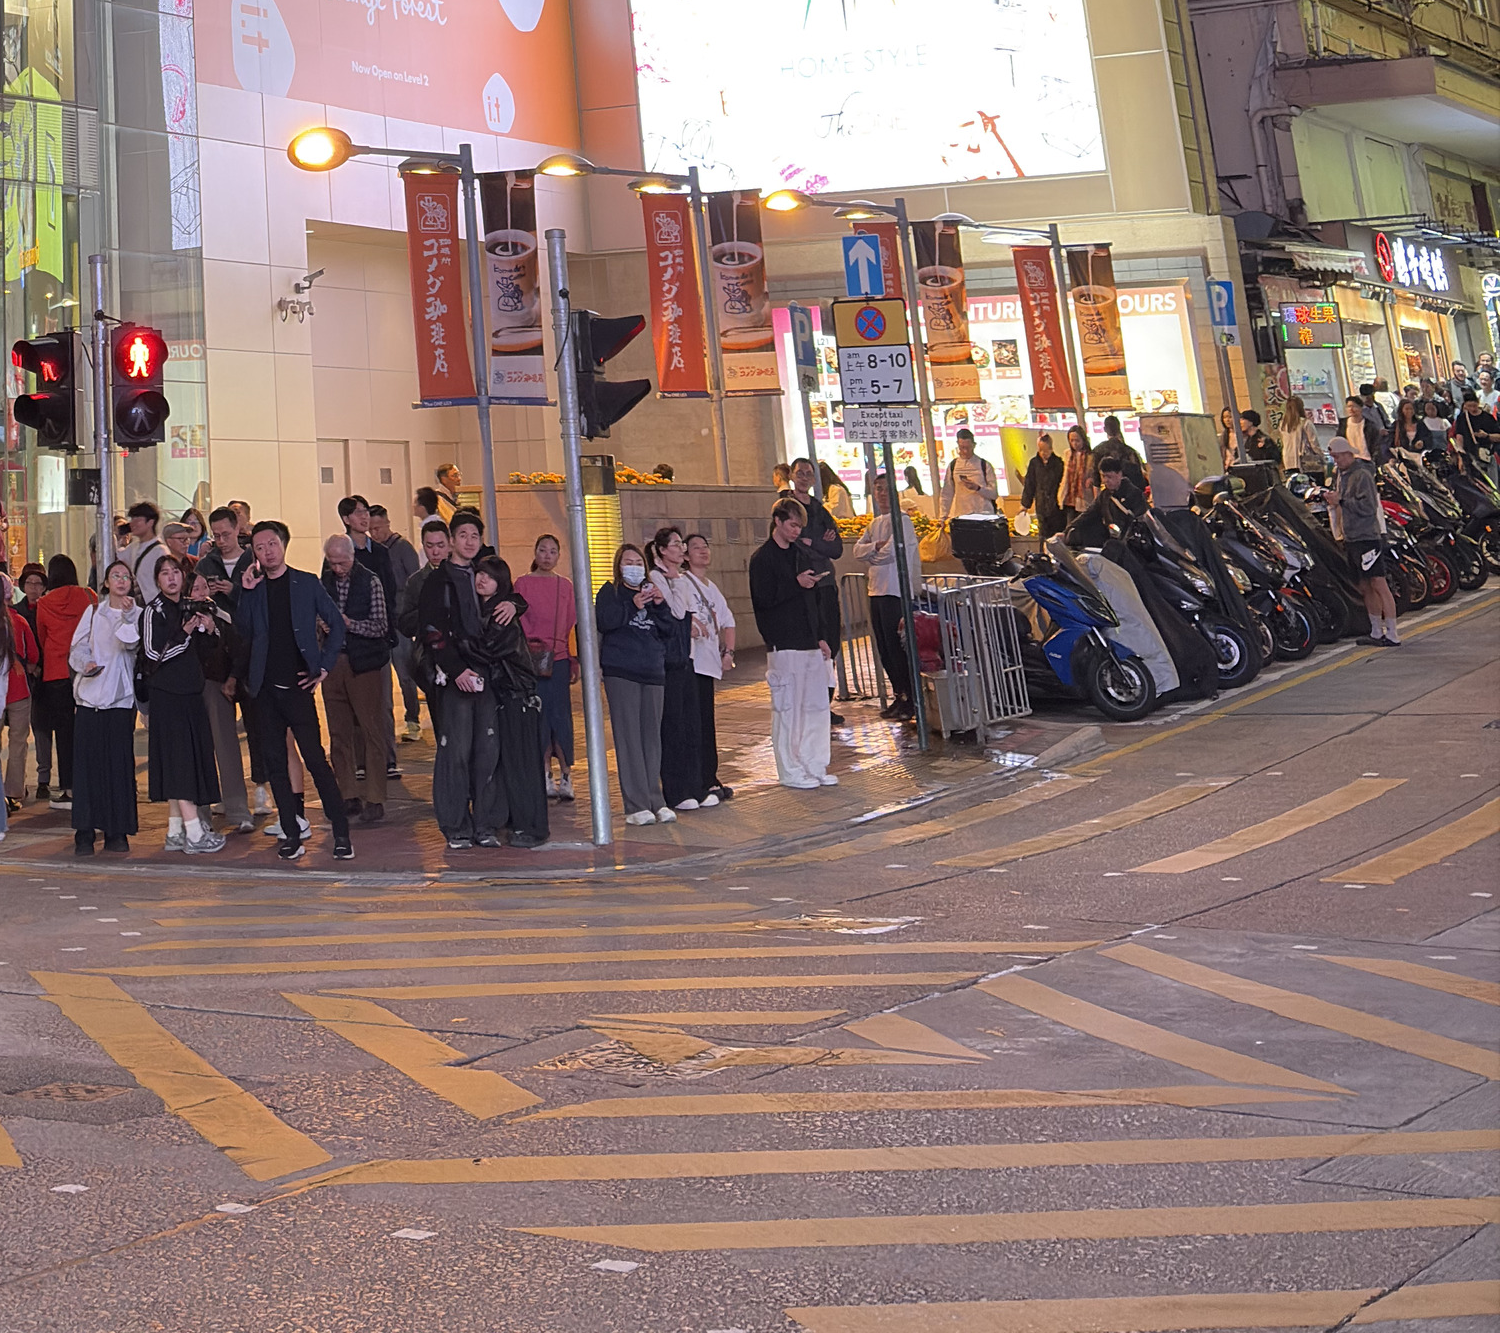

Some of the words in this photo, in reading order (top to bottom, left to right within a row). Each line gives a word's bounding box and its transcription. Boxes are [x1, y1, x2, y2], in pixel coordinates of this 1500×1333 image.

[781, 52, 854, 78] HOME
[864, 43, 928, 72] STYLE
[351, 60, 371, 76] Now
[372, 65, 392, 81] Open
[393, 71, 403, 80] on
[404, 71, 423, 85] Level
[423, 75, 429, 86] 2
[1211, 285, 1228, 322] P
[1283, 305, 1337, 324] 環球生果
[845, 359, 865, 372] 上午
[867, 352, 907, 369] 8-10
[847, 385, 868, 398] 下午
[870, 379, 904, 395] 5-7
[850, 378, 863, 386] pm
[852, 419, 868, 428] pick
[869, 419, 899, 428] up/drop
[901, 419, 913, 427] off
[861, 411, 888, 420] Except
[889, 411, 903, 419] taxi
[849, 429, 918, 440] 的士上落客除外
